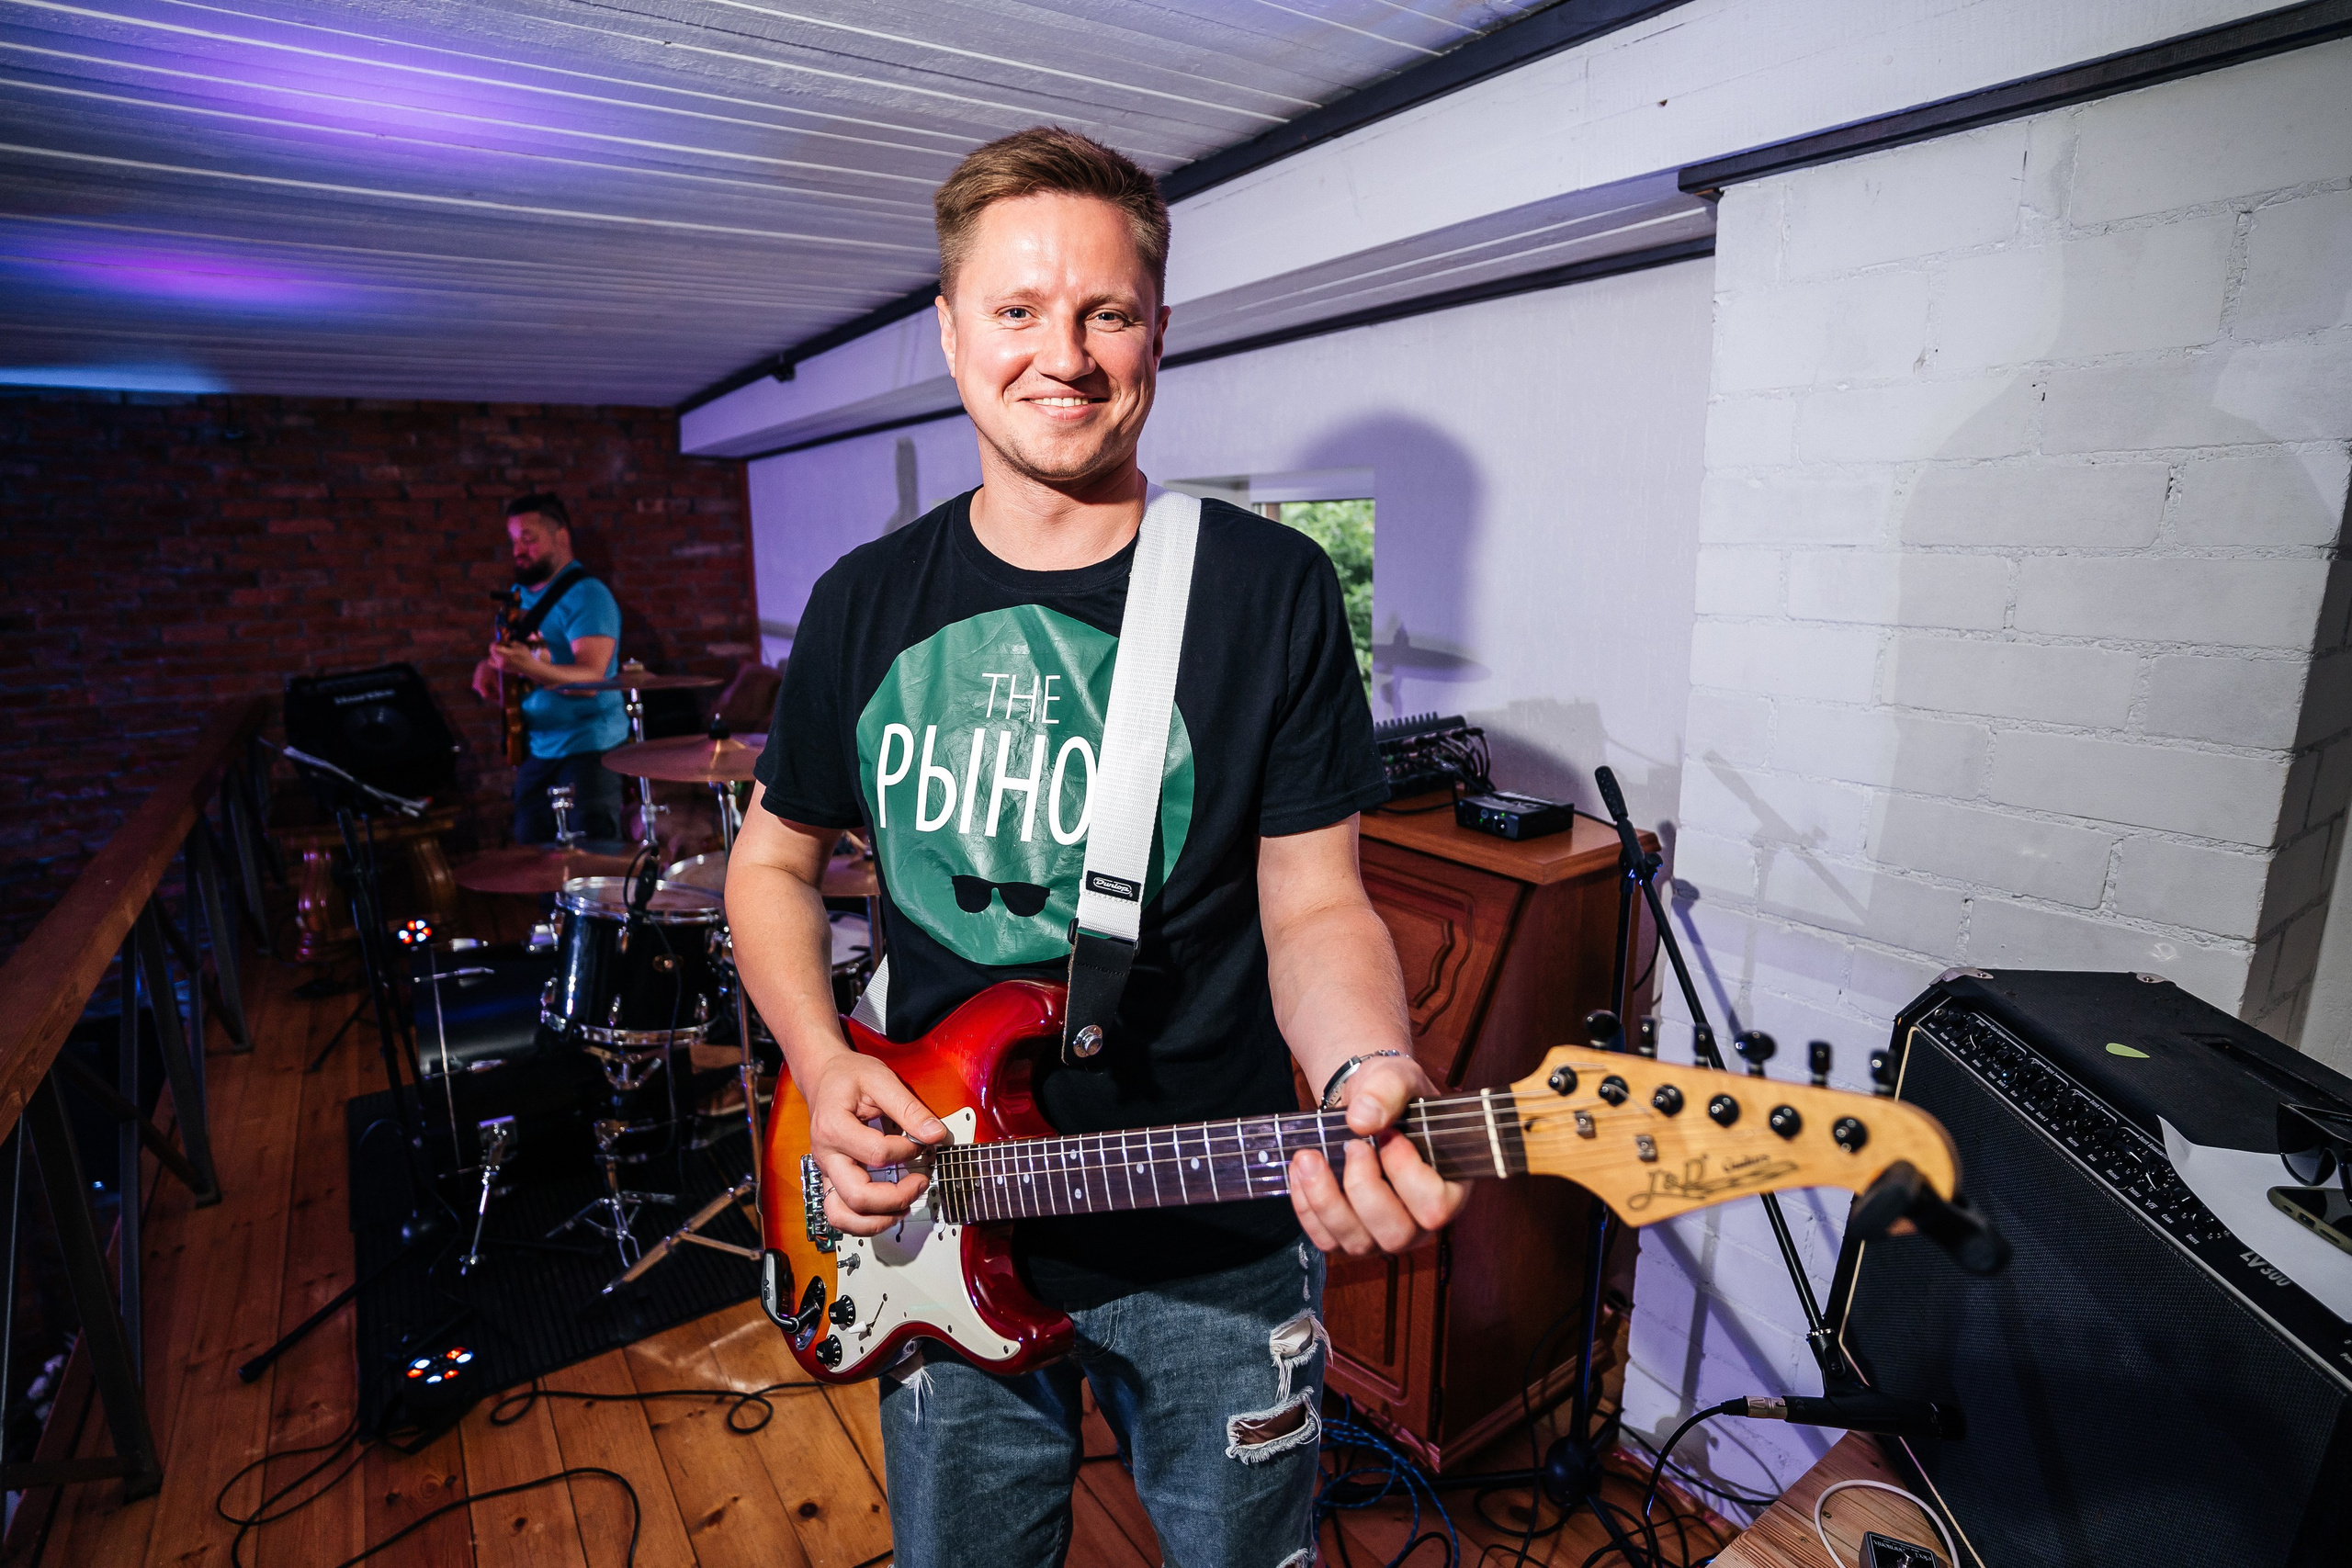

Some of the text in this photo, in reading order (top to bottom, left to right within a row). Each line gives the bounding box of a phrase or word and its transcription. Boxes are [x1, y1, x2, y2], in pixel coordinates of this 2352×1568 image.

[981, 671, 1061, 725] THE
[876, 722, 1098, 846] РЫНО
[1095, 879, 1130, 893] Dunlop
